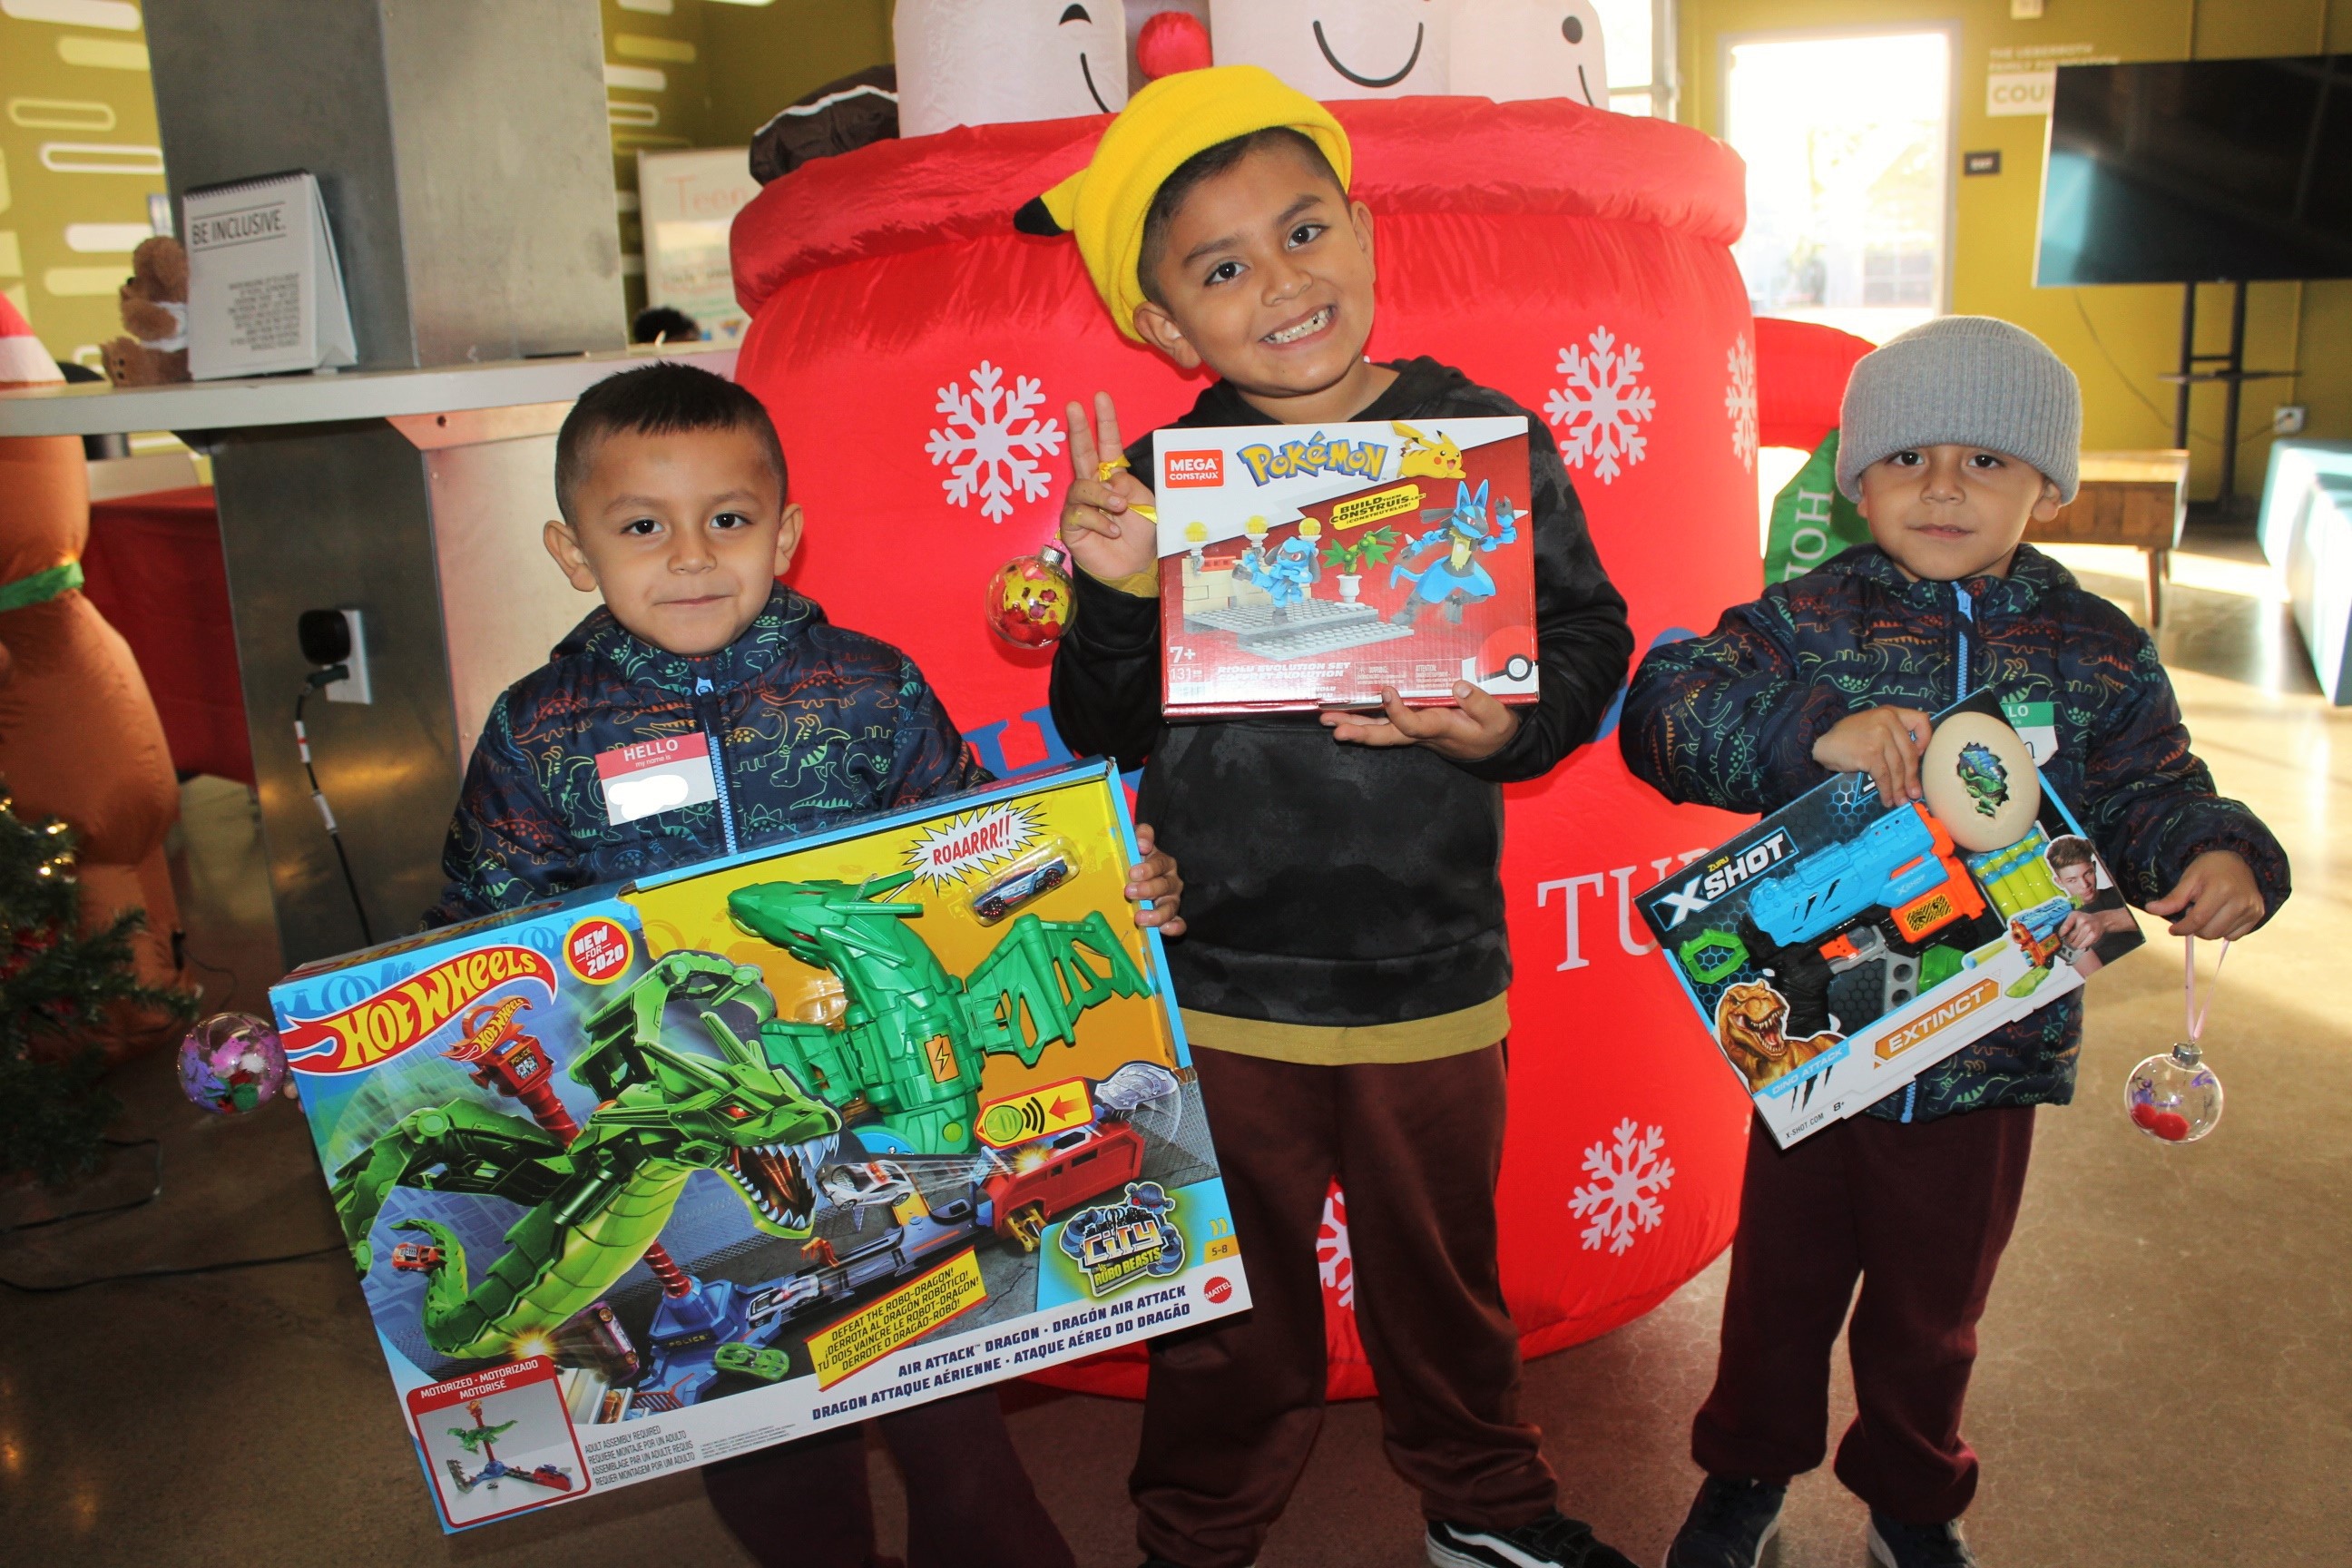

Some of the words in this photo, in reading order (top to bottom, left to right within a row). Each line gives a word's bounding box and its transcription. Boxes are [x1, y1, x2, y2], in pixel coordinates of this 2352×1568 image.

[1994, 84, 2046, 103] COU
[665, 175, 747, 215] Teen
[191, 222, 208, 245] BE
[212, 208, 286, 240] INCLUSIVE.
[1169, 471, 1219, 482] CONSTRUX
[1170, 458, 1218, 472] MEGA
[1340, 496, 1382, 514] BUILD
[1170, 645, 1196, 663] 7+
[1328, 662, 1351, 671] SET
[1170, 667, 1192, 681] 131
[623, 739, 680, 762] HELLO
[635, 760, 645, 769] my
[646, 756, 665, 765] name
[932, 814, 1012, 866] ROAARRR!!
[1707, 856, 1730, 873] ZURU
[999, 883, 1031, 899] POLICE
[1537, 848, 1710, 973] TU
[573, 925, 608, 956] NEW
[585, 945, 603, 961] FOR
[587, 944, 625, 977] 2020
[320, 998, 415, 1069] HOT
[1888, 986, 1987, 1053] EXTINCT
[510, 1048, 533, 1065] POLICE
[1772, 1075, 1798, 1094] DINO
[1800, 1047, 1844, 1081] ATTACK
[1833, 1101, 1845, 1112] 8+
[1785, 1112, 1825, 1139] X-SHOT.COM
[1211, 1244, 1228, 1257] 5-8
[1094, 1264, 1122, 1286] ROBO
[1123, 1247, 1162, 1272] BEASTS
[832, 1317, 865, 1341] DEFEAT
[867, 1308, 884, 1322] THE
[886, 1268, 954, 1311] ROBO-DRAGON!
[1205, 1281, 1232, 1300] MATTEL
[825, 1325, 867, 1358] ¡DERROTA
[870, 1320, 881, 1333] AL
[883, 1298, 920, 1328] DRAGÓN
[922, 1270, 968, 1306] ROBÓTICO!
[832, 1348, 852, 1366] DOIS
[854, 1326, 892, 1354] VAINCRE
[894, 1318, 905, 1331] LE
[906, 1277, 979, 1322] ROBOT-DRAGON!
[897, 1361, 922, 1377] AIR
[926, 1346, 975, 1370] ATTACK
[985, 1327, 1040, 1353] DRAGON
[1053, 1308, 1106, 1333] DRAGÓN
[1111, 1300, 1133, 1317] AIR
[1137, 1285, 1187, 1308] ATTACK
[812, 1394, 867, 1421] DRAGON
[871, 1377, 931, 1405] ATTAQUE
[934, 1358, 1002, 1387] AÉRIENNE
[1014, 1338, 1064, 1364] ATAQUE
[1068, 1327, 1112, 1349] AÉREO
[1115, 1319, 1133, 1335] DO
[1137, 1303, 1191, 1328] DRAGÃO
[842, 1341, 883, 1371] DERROTE
[421, 1377, 473, 1398] MOTORIZED
[479, 1359, 539, 1383] MOTORIZADO
[459, 1378, 506, 1400] MOTORISÉ
[584, 1441, 602, 1454] ADULT
[603, 1434, 632, 1449] ASSEMBLY
[632, 1425, 662, 1442] REQUIRED
[588, 1451, 616, 1465] REQUIERE
[617, 1443, 642, 1458] MONTAJE
[643, 1440, 654, 1453] POR
[655, 1438, 664, 1449] UN
[665, 1430, 687, 1446] ADULTO
[592, 1458, 629, 1476] ASSEMBLAGE
[630, 1455, 642, 1466] PAR
[642, 1452, 652, 1463] UN
[652, 1446, 672, 1460] ADULTE
[672, 1440, 694, 1455] REQUIS
[595, 1472, 618, 1487] REQUER
[619, 1463, 651, 1481] MONTAGEM
[652, 1459, 663, 1472] POR
[673, 1452, 695, 1466] ADULTO
